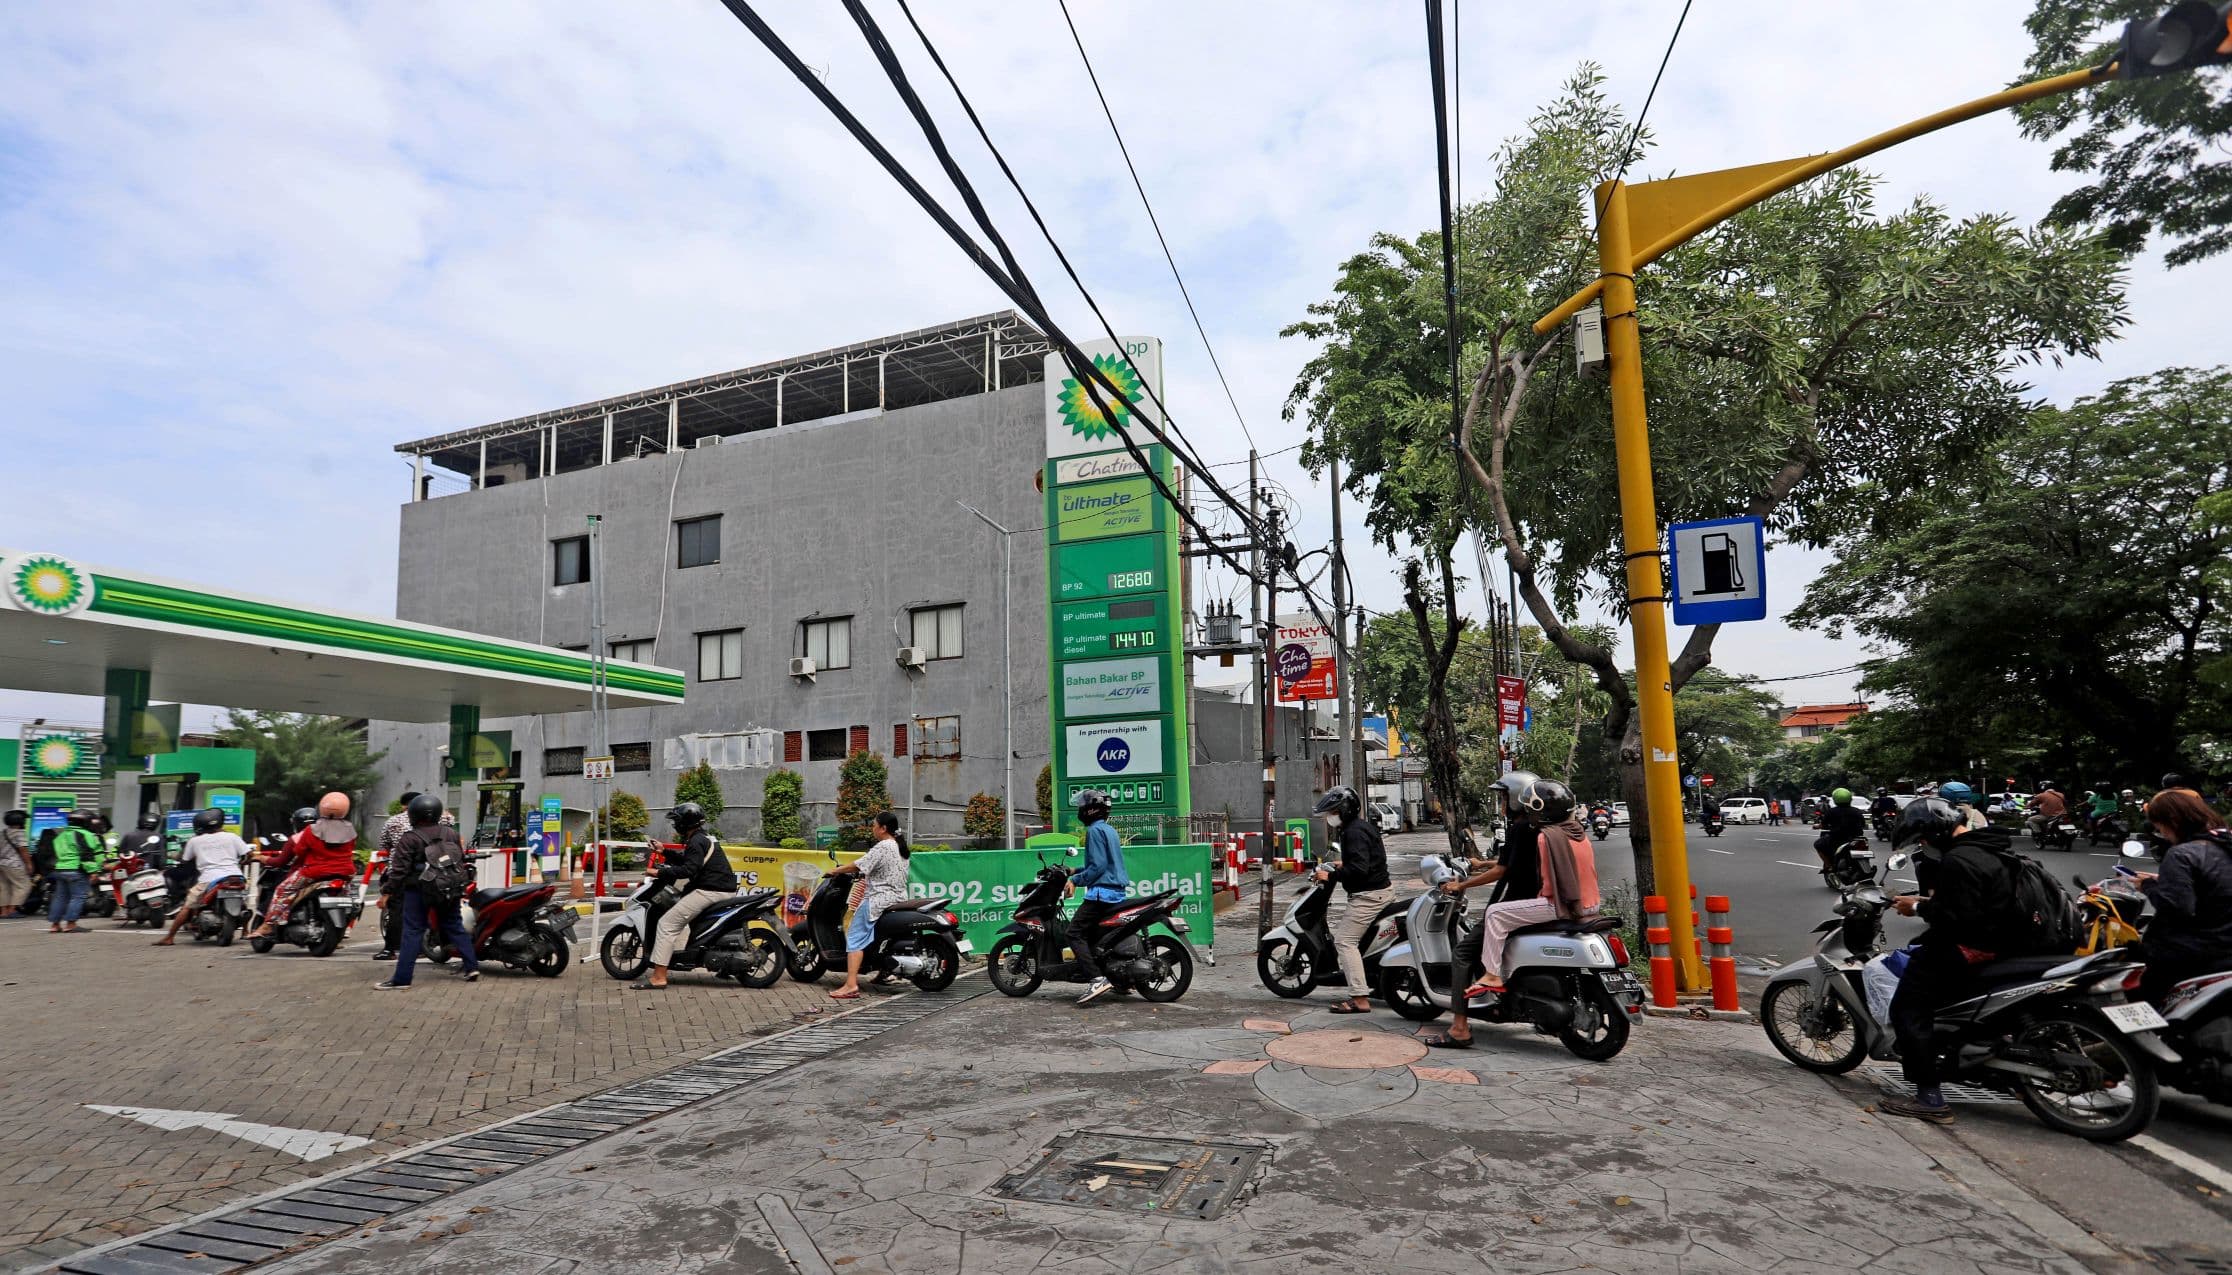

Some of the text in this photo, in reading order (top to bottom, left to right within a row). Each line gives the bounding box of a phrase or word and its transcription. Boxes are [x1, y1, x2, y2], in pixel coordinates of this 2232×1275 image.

[1126, 341, 1148, 357] bp
[1063, 492, 1131, 512] ultimate
[1104, 515, 1141, 526] ACTIVE
[1062, 582, 1083, 592] BP 92
[1113, 571, 1152, 589] 12680
[1063, 611, 1106, 621] BP ultimate
[1063, 634, 1107, 644] BP ultimate
[1064, 645, 1086, 654] diesel
[1279, 649, 1308, 664] Cha
[1281, 661, 1308, 677] time
[1066, 671, 1145, 686] Bahan Bakar BP
[1108, 686, 1151, 696] ACTIVE
[1088, 726, 1130, 736] partnership
[1131, 725, 1148, 733] with
[1099, 749, 1128, 761] AKR
[733, 871, 758, 885] T'S
[908, 880, 984, 905] BP92
[1125, 872, 1202, 898] sedia!
[961, 908, 1002, 923] bakar
